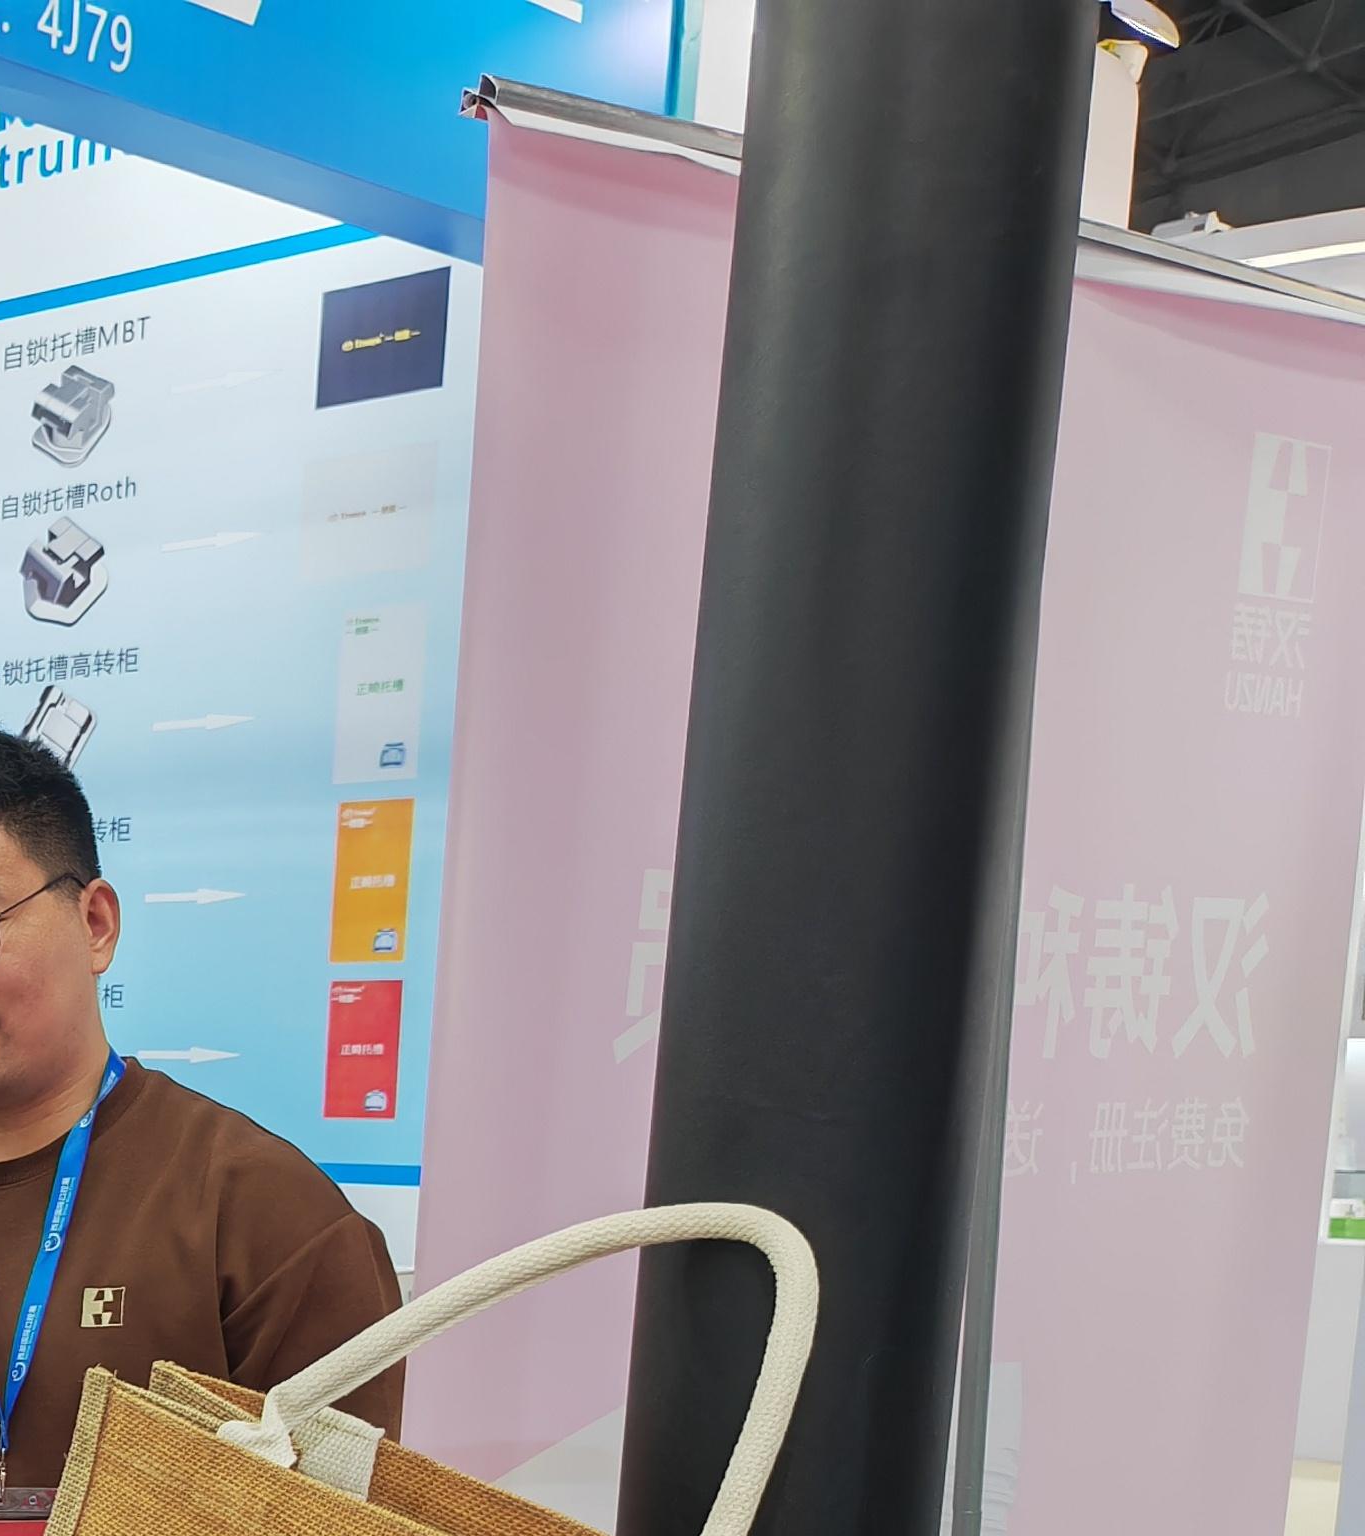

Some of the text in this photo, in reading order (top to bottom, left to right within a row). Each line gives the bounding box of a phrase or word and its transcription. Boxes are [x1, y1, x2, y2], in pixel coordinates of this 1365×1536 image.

[37, 2, 133, 72] 4J79
[3, 316, 152, 372] 自锁托槽MBT
[0, 476, 137, 521] 自锁托槽Roth
